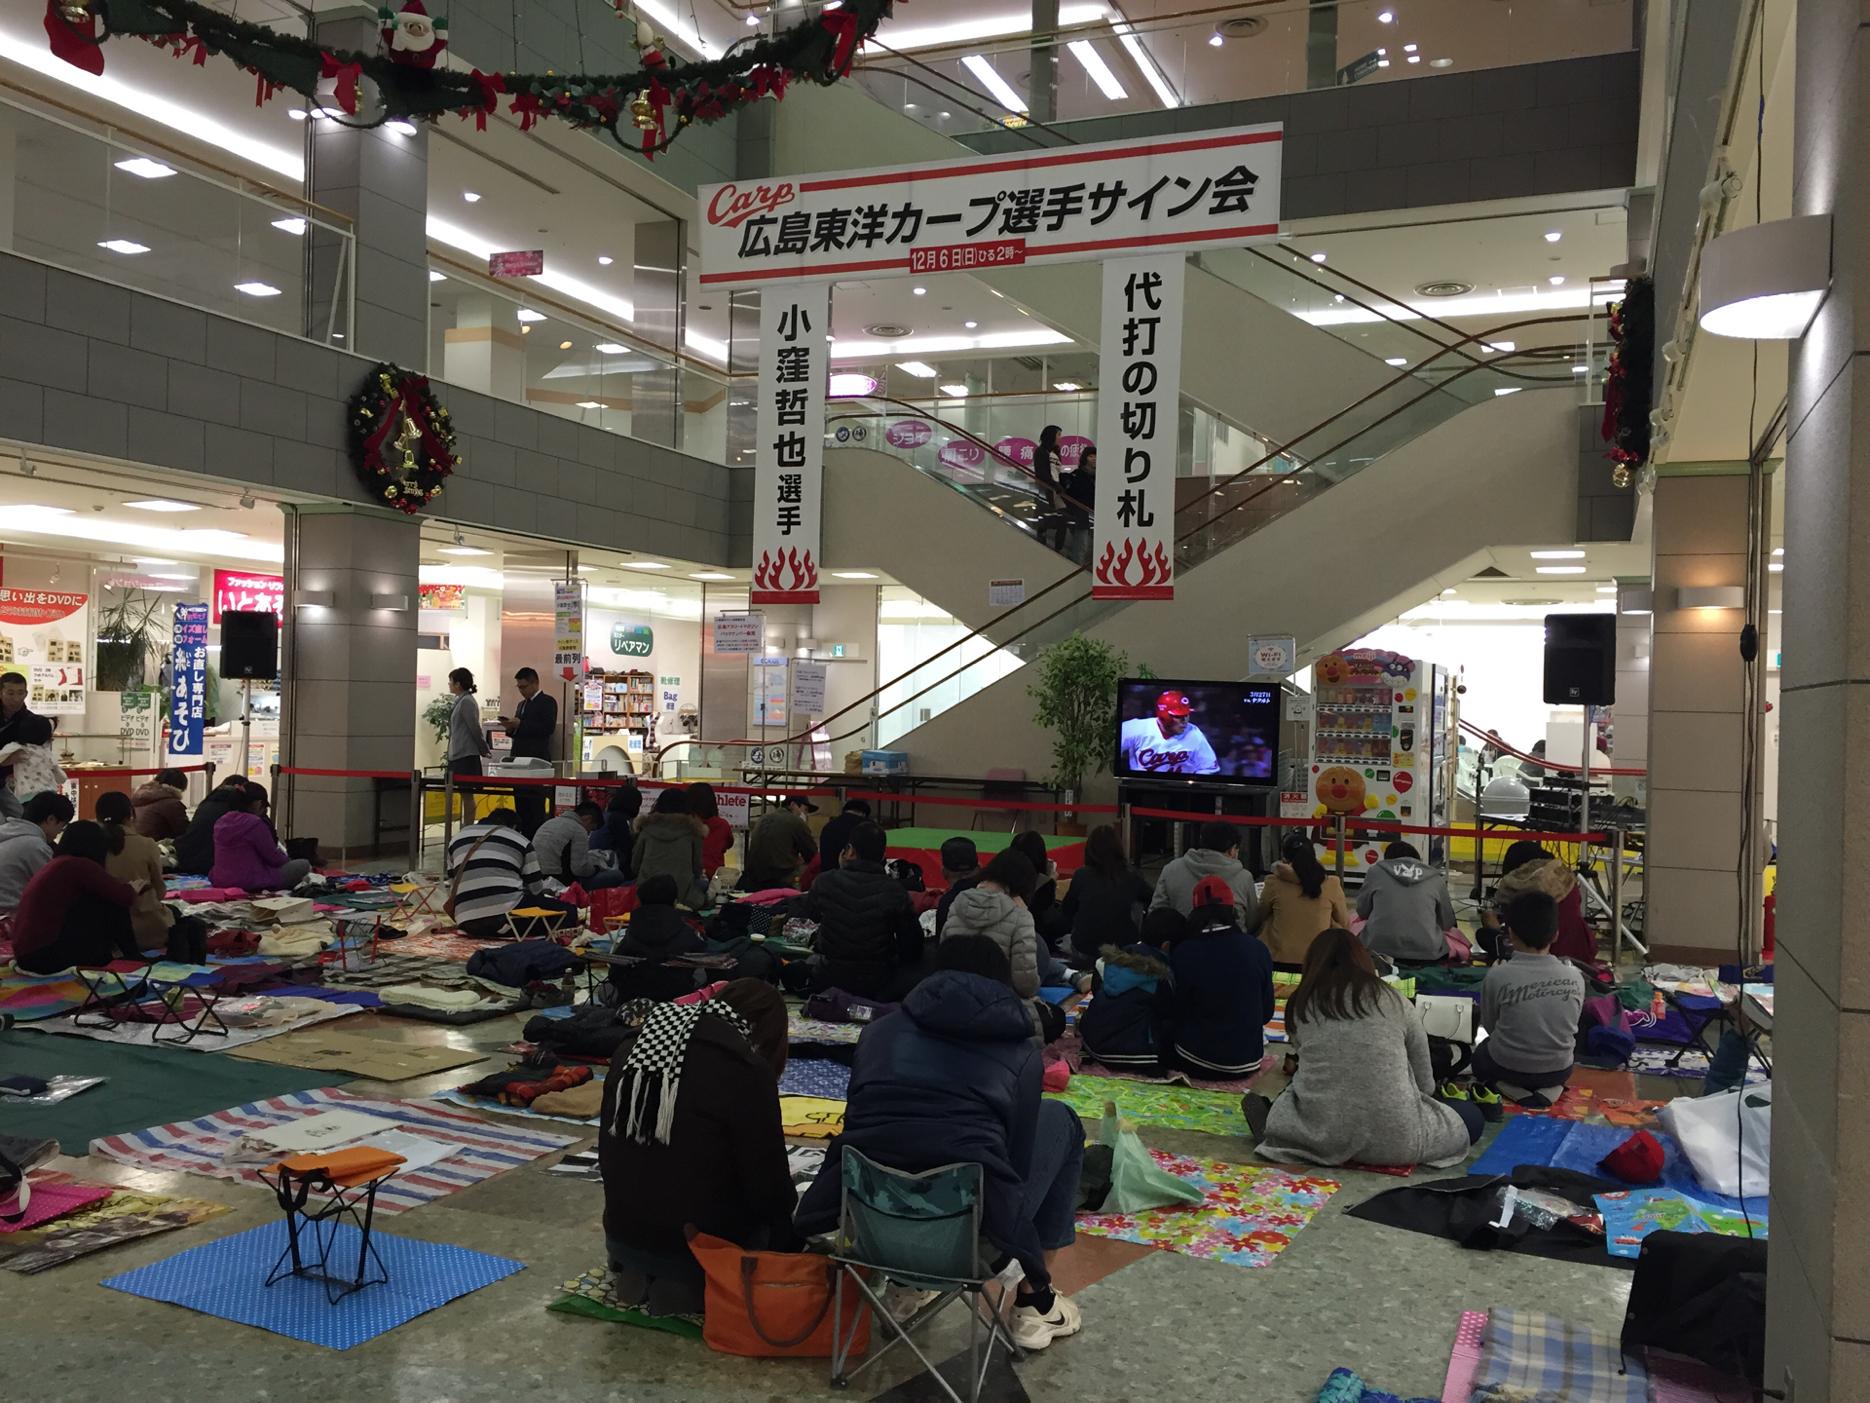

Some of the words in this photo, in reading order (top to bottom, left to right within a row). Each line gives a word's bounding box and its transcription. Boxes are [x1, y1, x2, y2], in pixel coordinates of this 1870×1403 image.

[707, 183, 795, 228] Carp
[737, 165, 1260, 258] 広島東洋カープ選手サイン会
[773, 303, 812, 536] 小窪哲也選手
[1117, 272, 1163, 528] 代打の切り札
[193, 647, 206, 718] お直し専門店
[555, 653, 581, 664] 最前列
[663, 691, 678, 702] Bag
[717, 794, 746, 807] hlete
